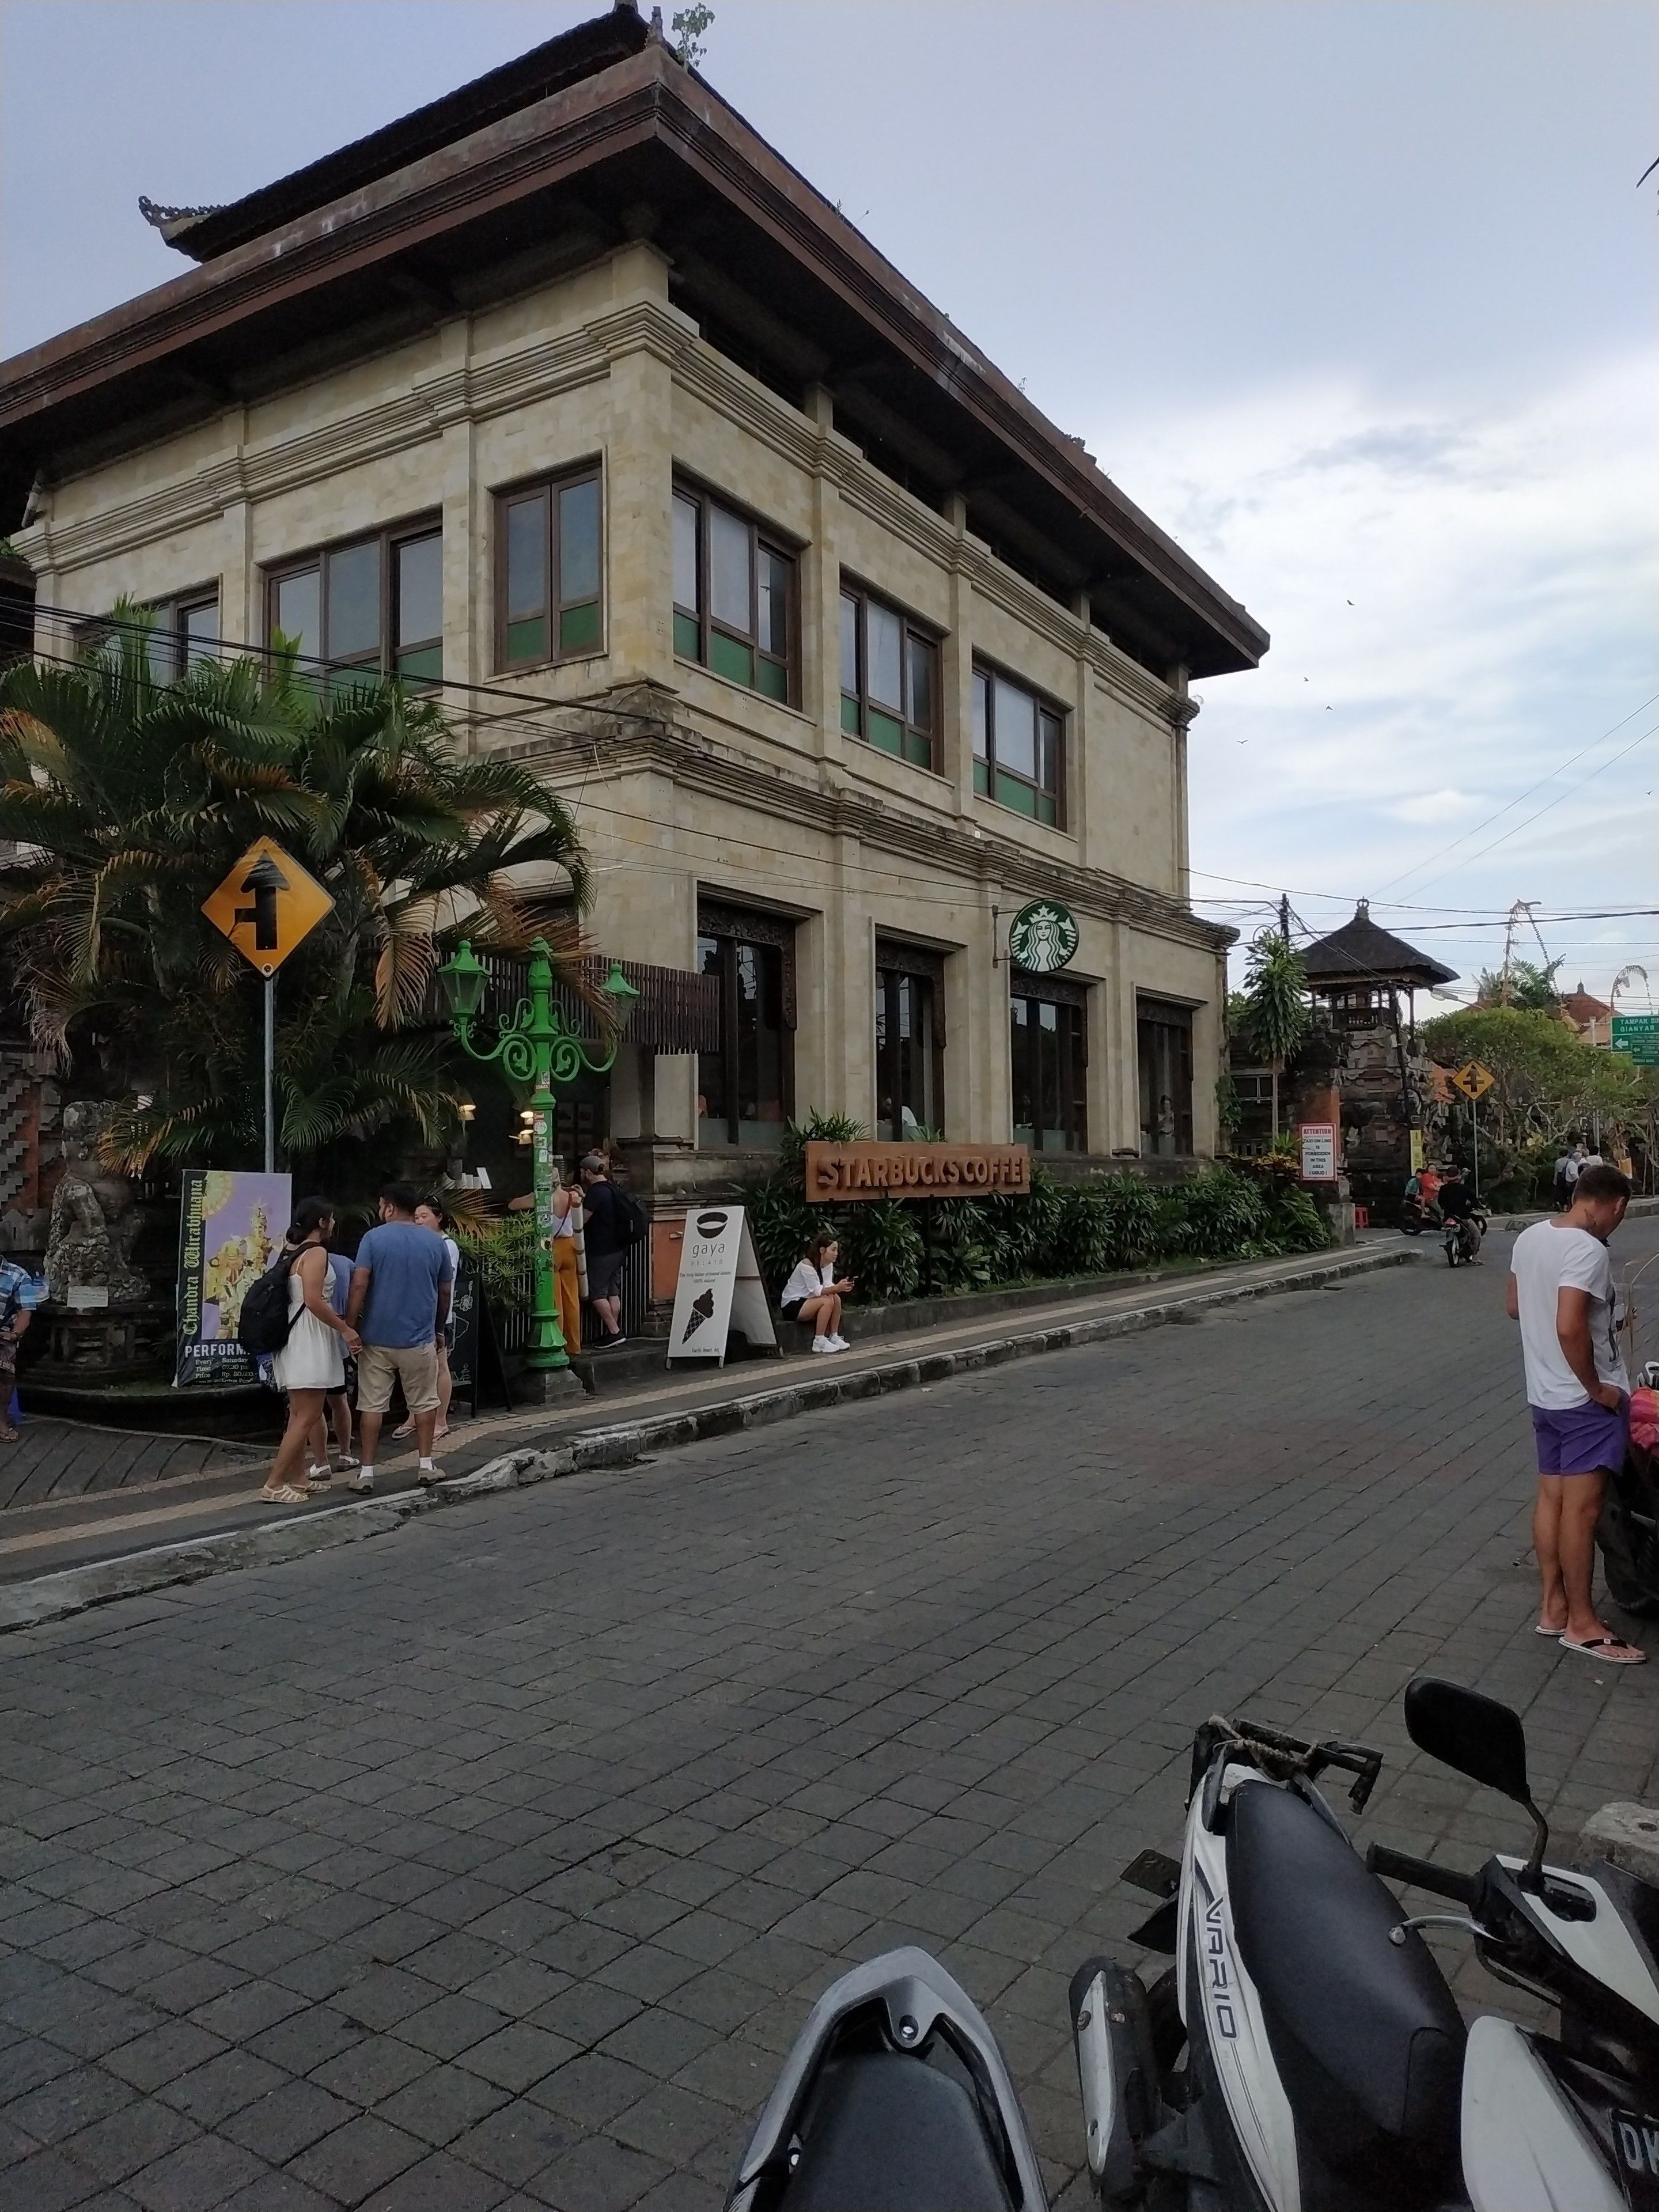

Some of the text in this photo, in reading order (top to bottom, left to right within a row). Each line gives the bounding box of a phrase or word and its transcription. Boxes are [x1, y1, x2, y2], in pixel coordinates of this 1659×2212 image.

[818, 1157, 960, 1188] STARBUCKS
[182, 1180, 203, 1335] Chandra Wirabhuana
[692, 1243, 725, 1258] gaya
[184, 1343, 251, 1358] PERFORM
[1206, 1896, 1237, 2038] VARIO
